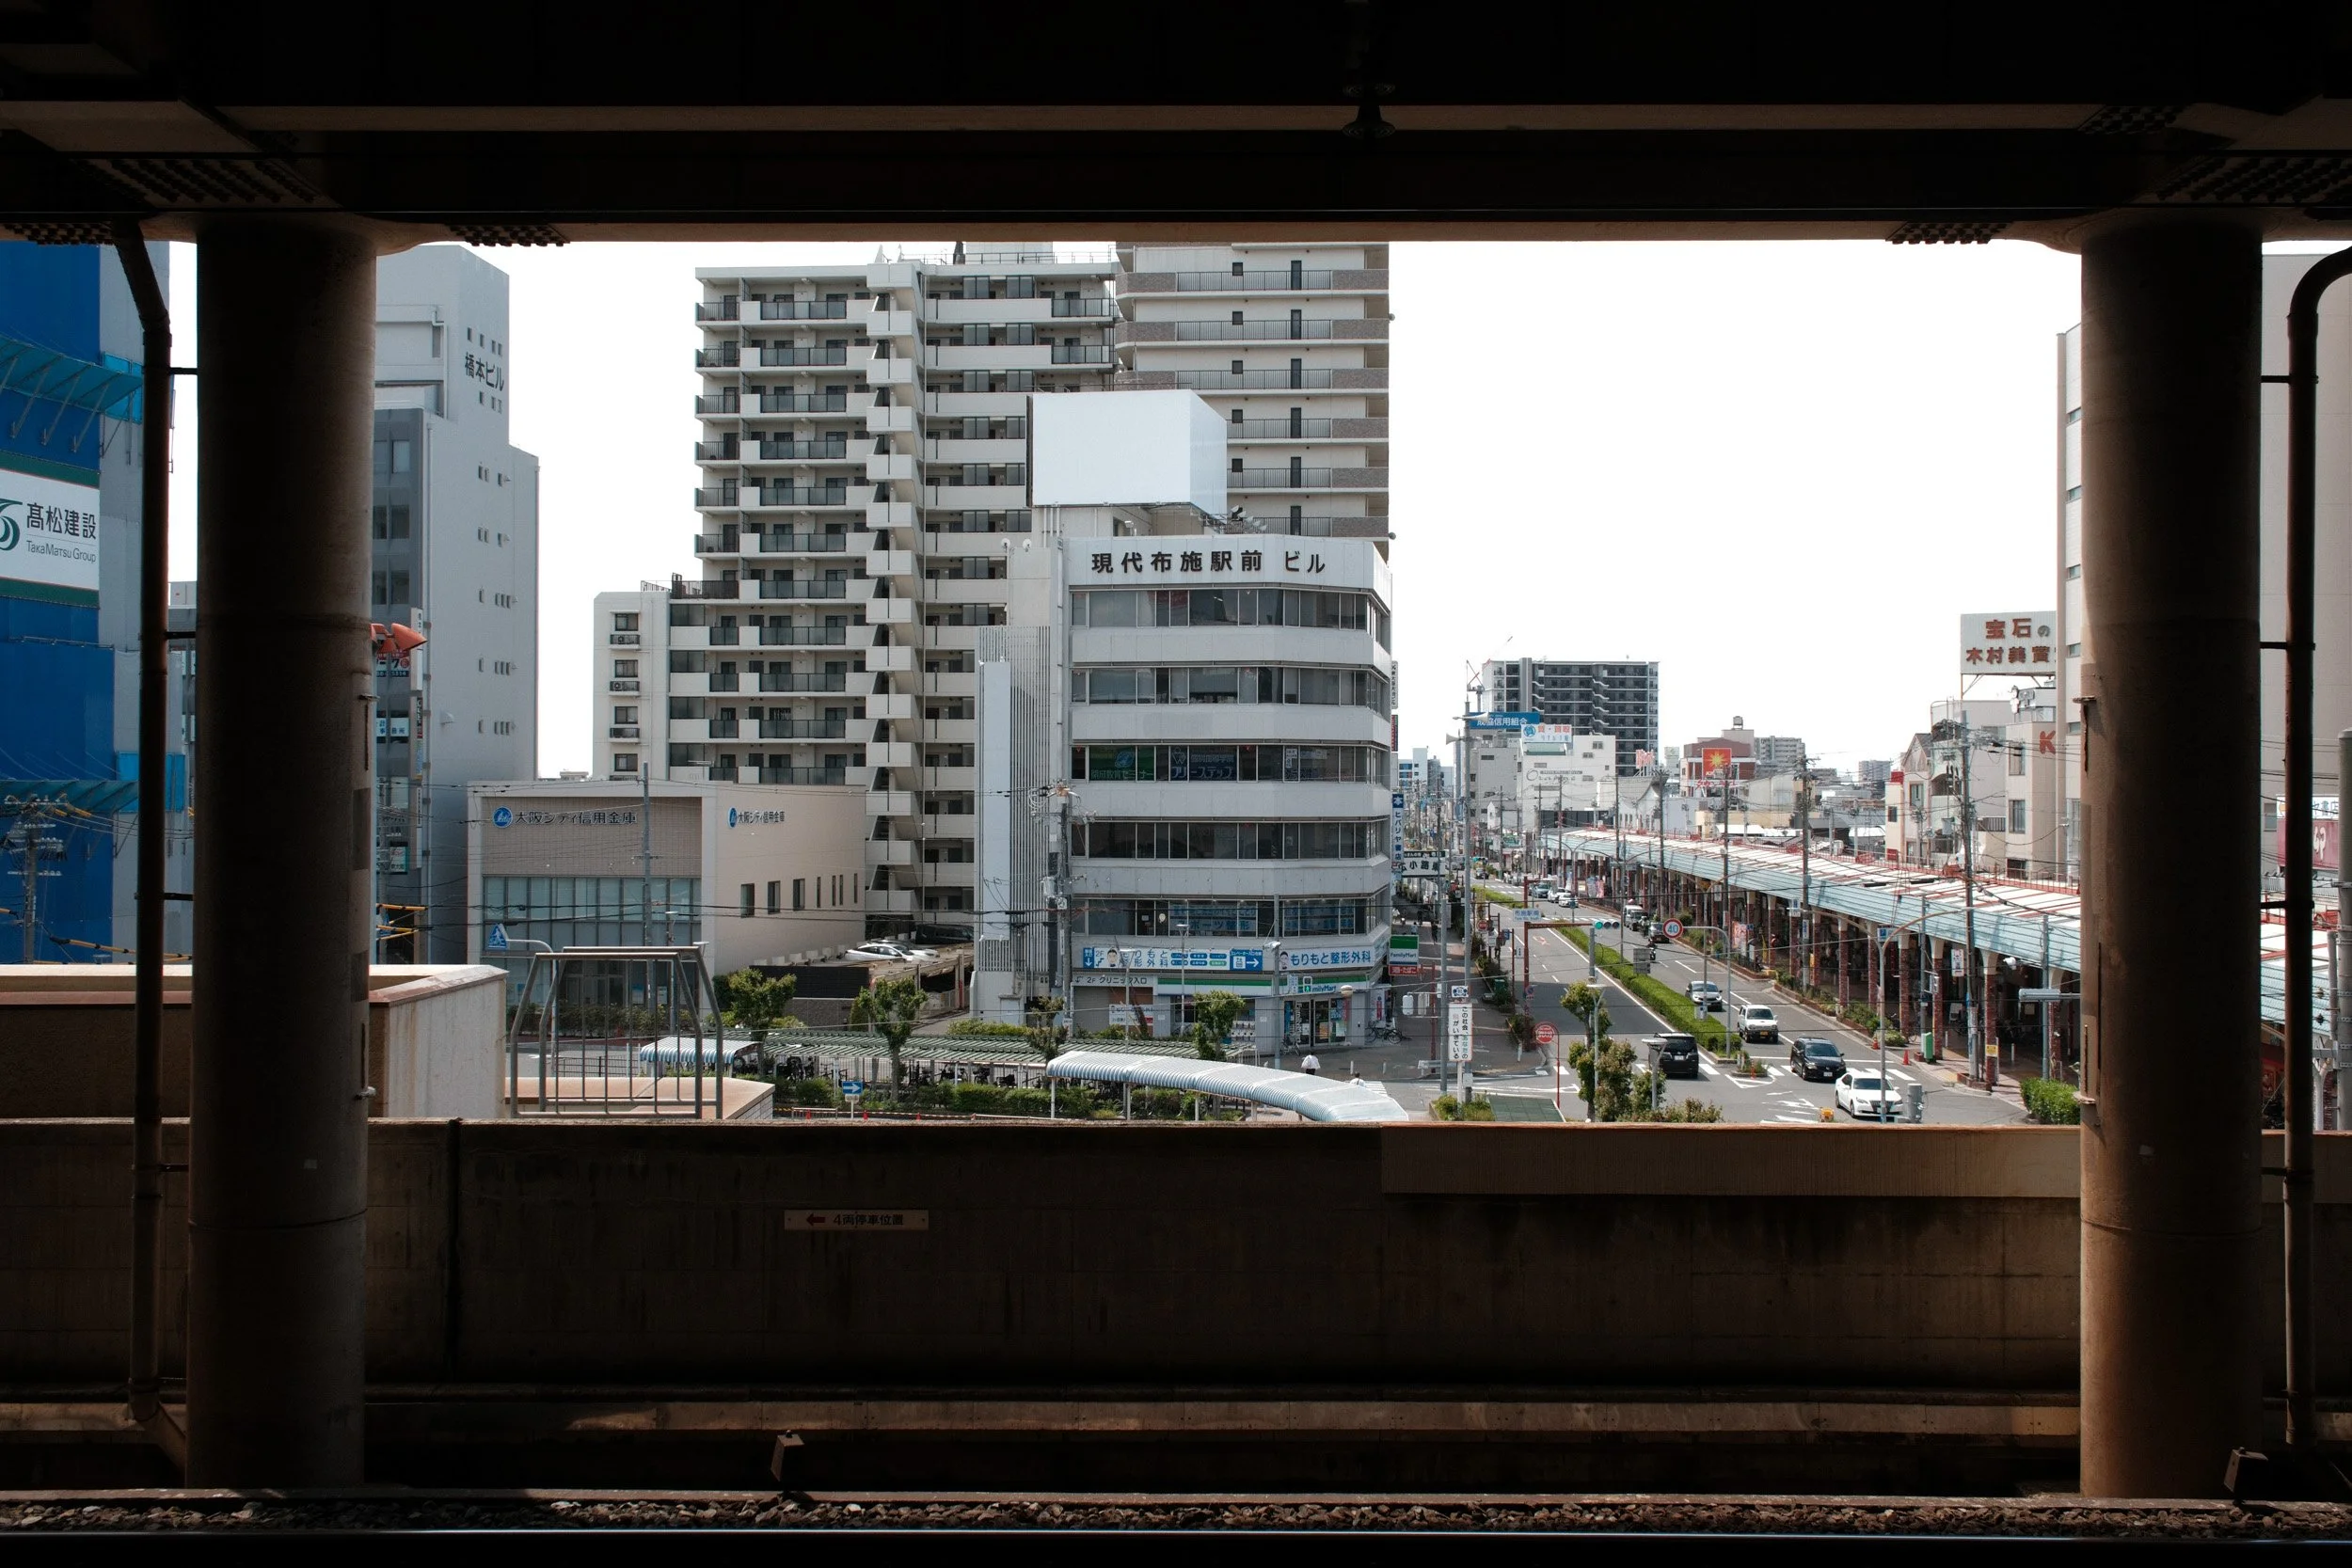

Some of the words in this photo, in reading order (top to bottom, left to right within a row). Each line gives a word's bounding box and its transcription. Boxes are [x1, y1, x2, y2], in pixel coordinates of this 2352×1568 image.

[465, 351, 504, 391] 橋本ビル
[72, 547, 96, 563] Group
[1985, 618, 2051, 640] 宝石の
[2040, 730, 2057, 754] K
[1392, 796, 1403, 806] 本
[516, 811, 637, 824] 大阪シティ信用金庫
[739, 811, 786, 824] 大阪シティ信用金庫
[1667, 924, 1678, 933] 40
[1290, 951, 1372, 966] もりもと整形外科
[1311, 984, 1337, 992] milyMart
[833, 1213, 904, 1226] 4両停車位置
